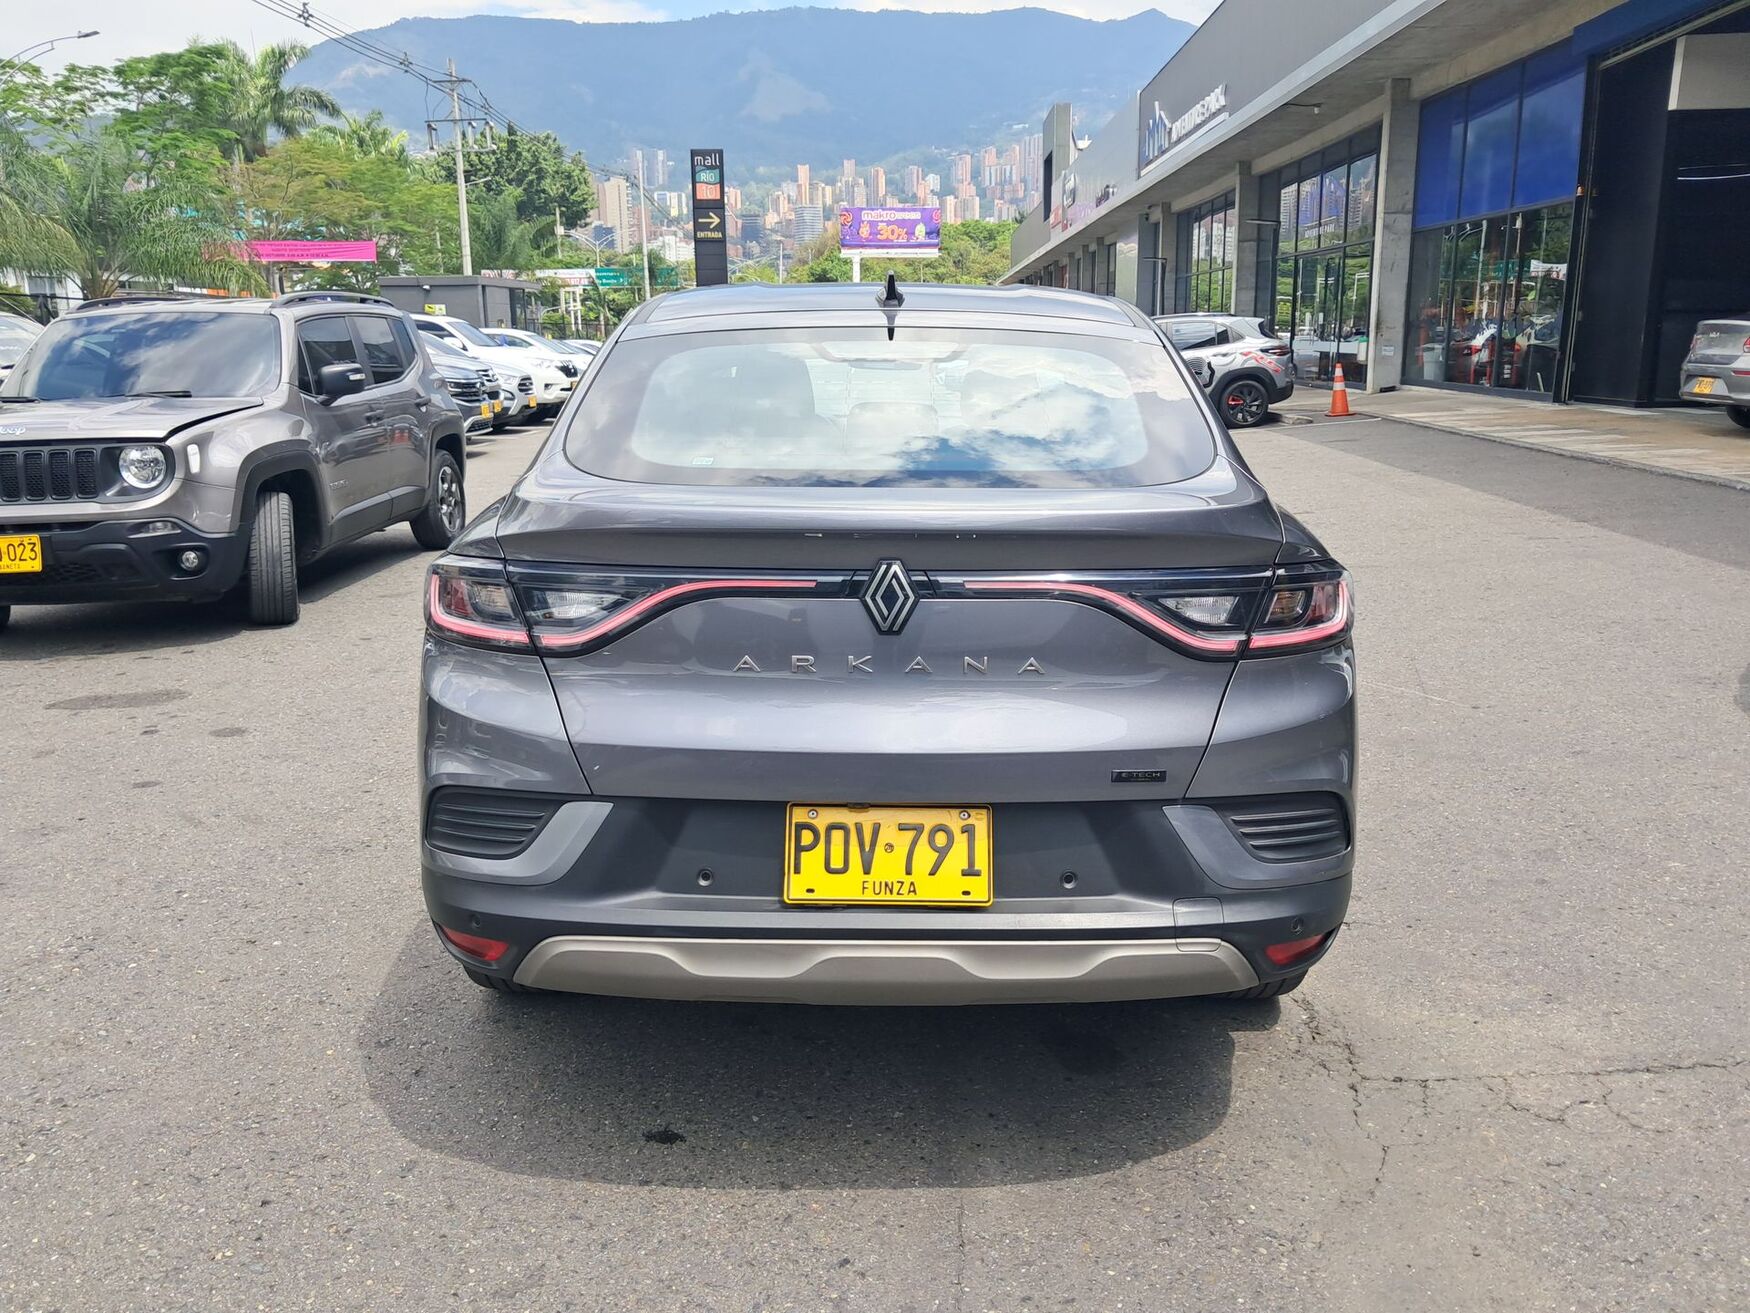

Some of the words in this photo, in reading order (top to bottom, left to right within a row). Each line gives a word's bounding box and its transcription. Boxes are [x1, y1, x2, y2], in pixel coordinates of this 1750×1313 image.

[694, 153, 720, 166] mall
[862, 209, 897, 221] makro
[697, 231, 723, 239] ENTRADA
[0, 425, 26, 436] eep
[7, 542, 38, 562] 023
[732, 655, 1046, 675] ARKANA
[793, 822, 881, 875] POV
[897, 822, 982, 876] 791
[861, 880, 918, 896] FUNZA
